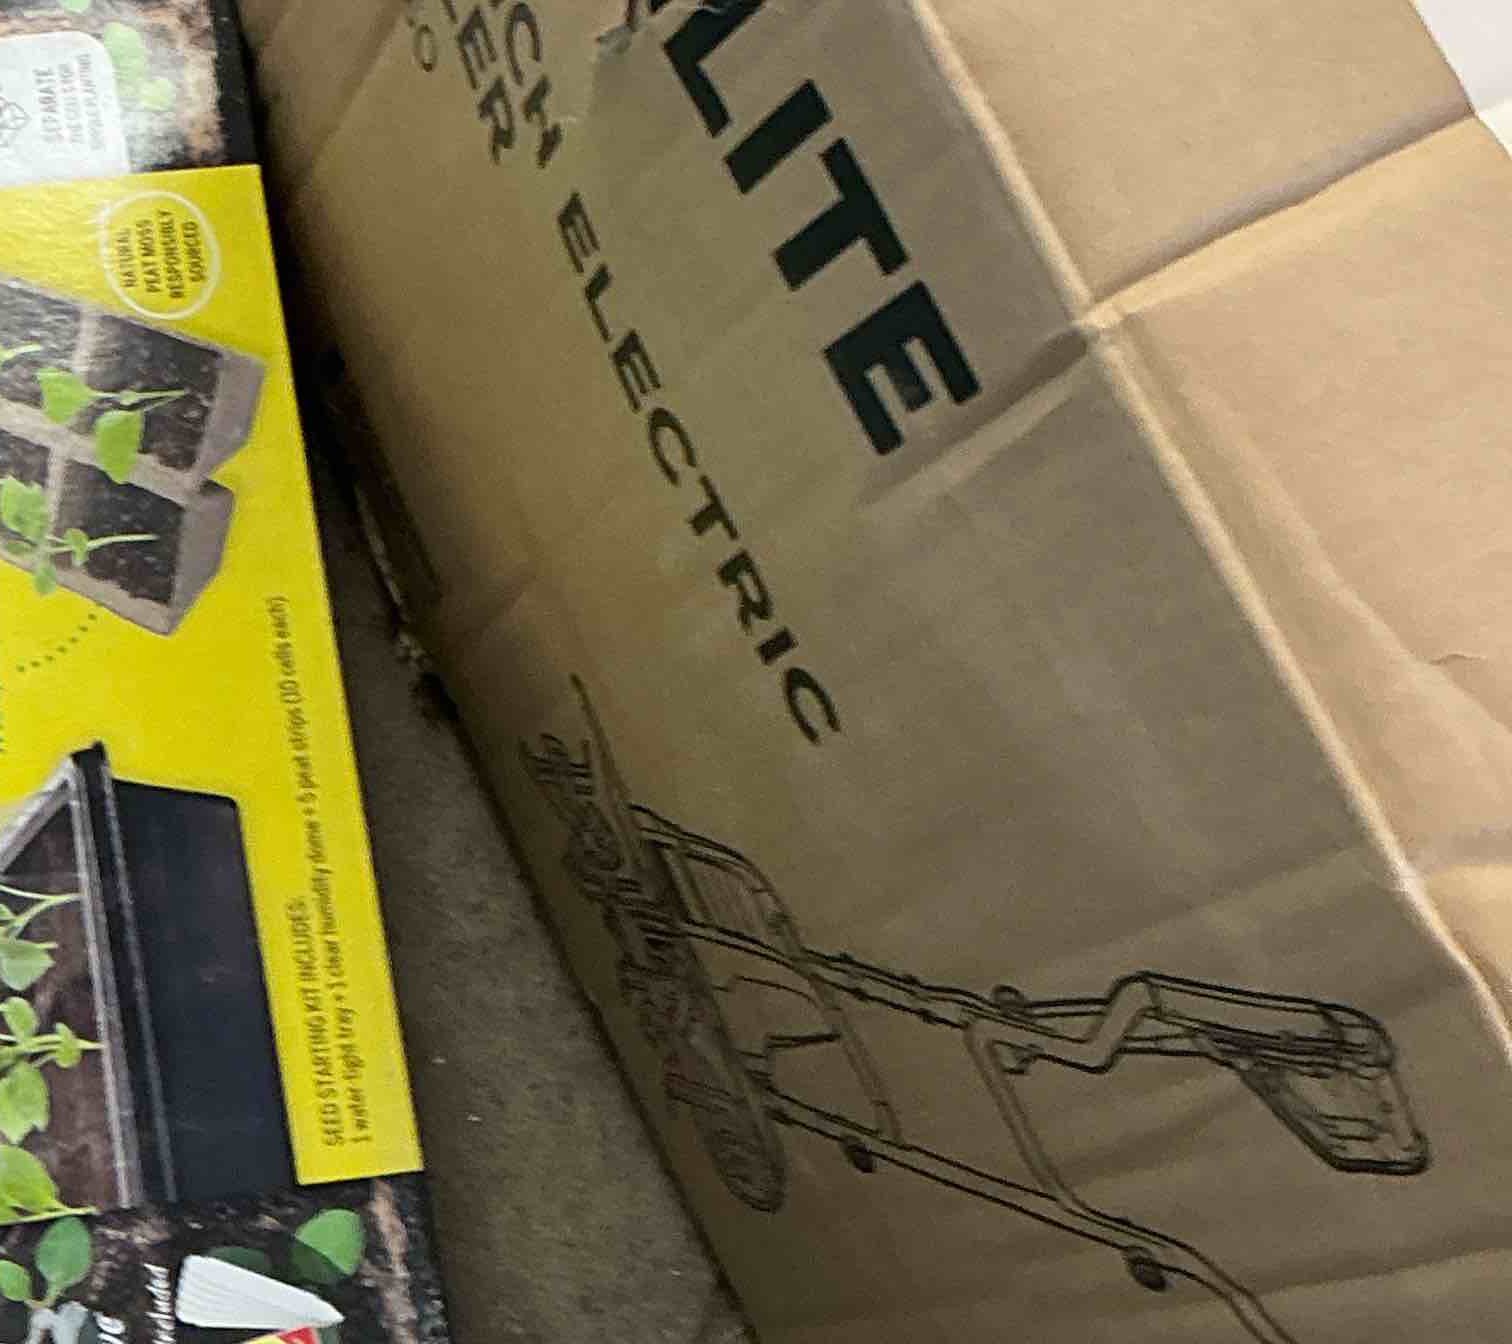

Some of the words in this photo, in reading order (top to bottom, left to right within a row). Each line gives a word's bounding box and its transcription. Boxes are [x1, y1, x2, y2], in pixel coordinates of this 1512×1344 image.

[34, 66, 64, 144] SEPARATE
[110, 227, 138, 289] NATURAL
[133, 218, 156, 258] MOSS
[153, 207, 186, 300] RESPONSIBLY
[179, 219, 207, 283] SOURCED
[141, 259, 162, 294] PEAT
[556, 190, 842, 746] ELECTRIC
[269, 641, 296, 677] cells
[282, 705, 311, 752] strips
[291, 753, 317, 791] peat
[301, 819, 326, 865] dome
[306, 865, 343, 937] humidity
[282, 897, 319, 981] INCLUDES:
[320, 937, 343, 976] clear
[297, 981, 321, 1014] KIT
[331, 1004, 362, 1039] tray
[301, 1013, 337, 1099] STARTING
[315, 1101, 344, 1147] SEED
